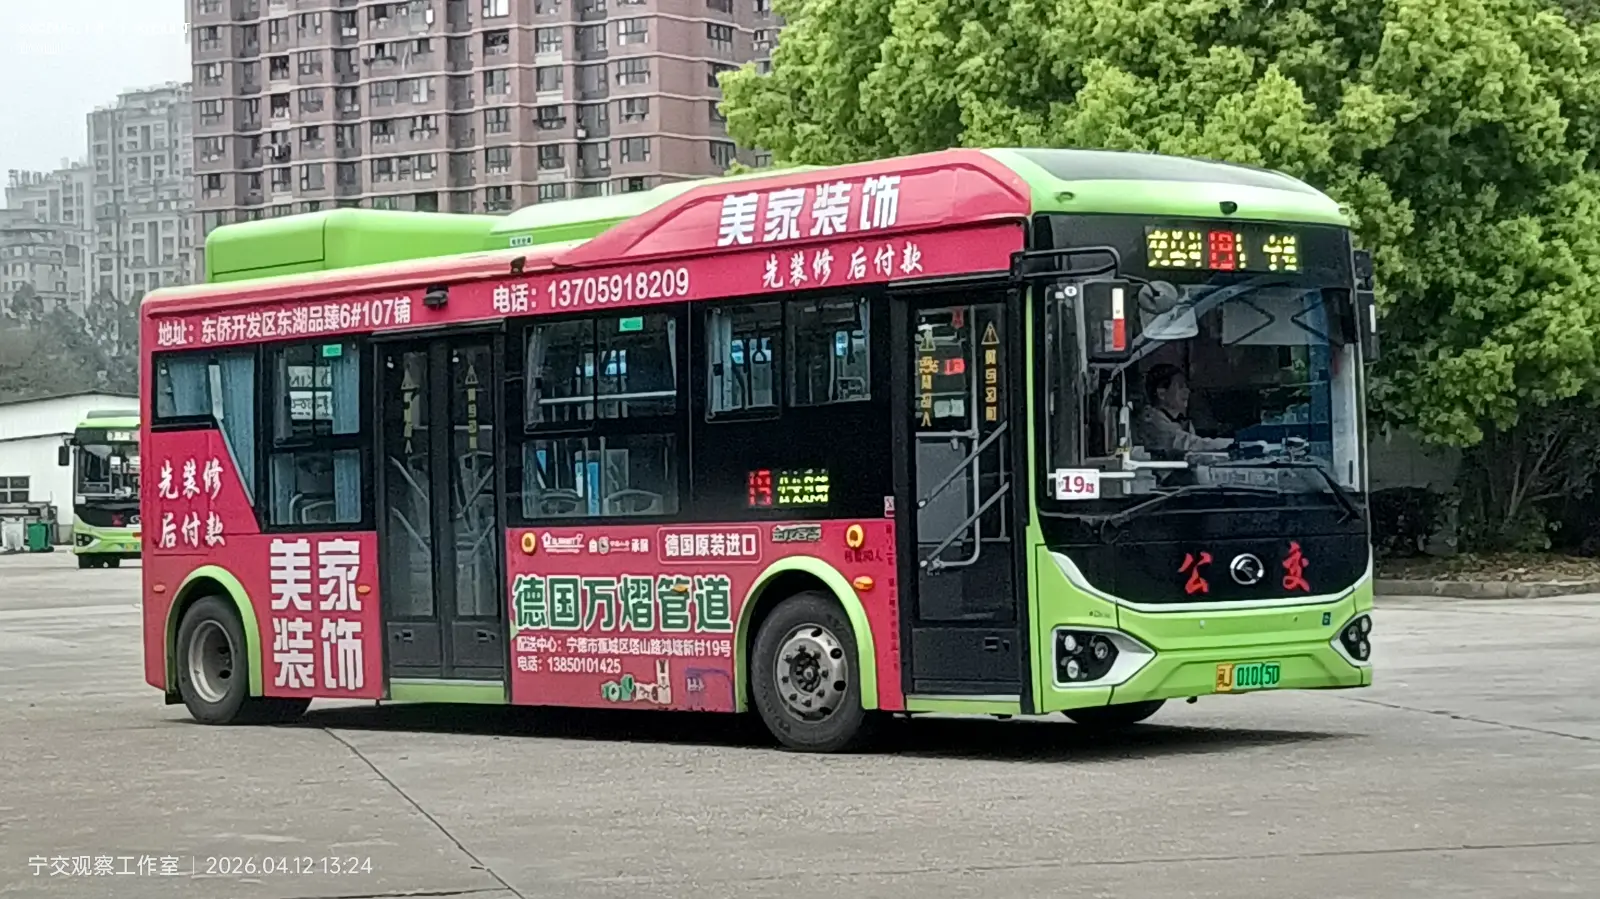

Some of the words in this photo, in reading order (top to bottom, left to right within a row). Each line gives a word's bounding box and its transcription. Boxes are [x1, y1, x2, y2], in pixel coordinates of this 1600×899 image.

[717, 175, 901, 248] 美家装饰
[762, 252, 832, 289] 先装修
[846, 242, 924, 281] 后付款
[157, 458, 224, 500] 先装修
[158, 511, 226, 549] 后付款
[664, 533, 757, 557] 德国原装进口
[269, 538, 362, 611] 美家
[511, 573, 735, 633] 德国万熠管道
[272, 617, 364, 690] 装饰
